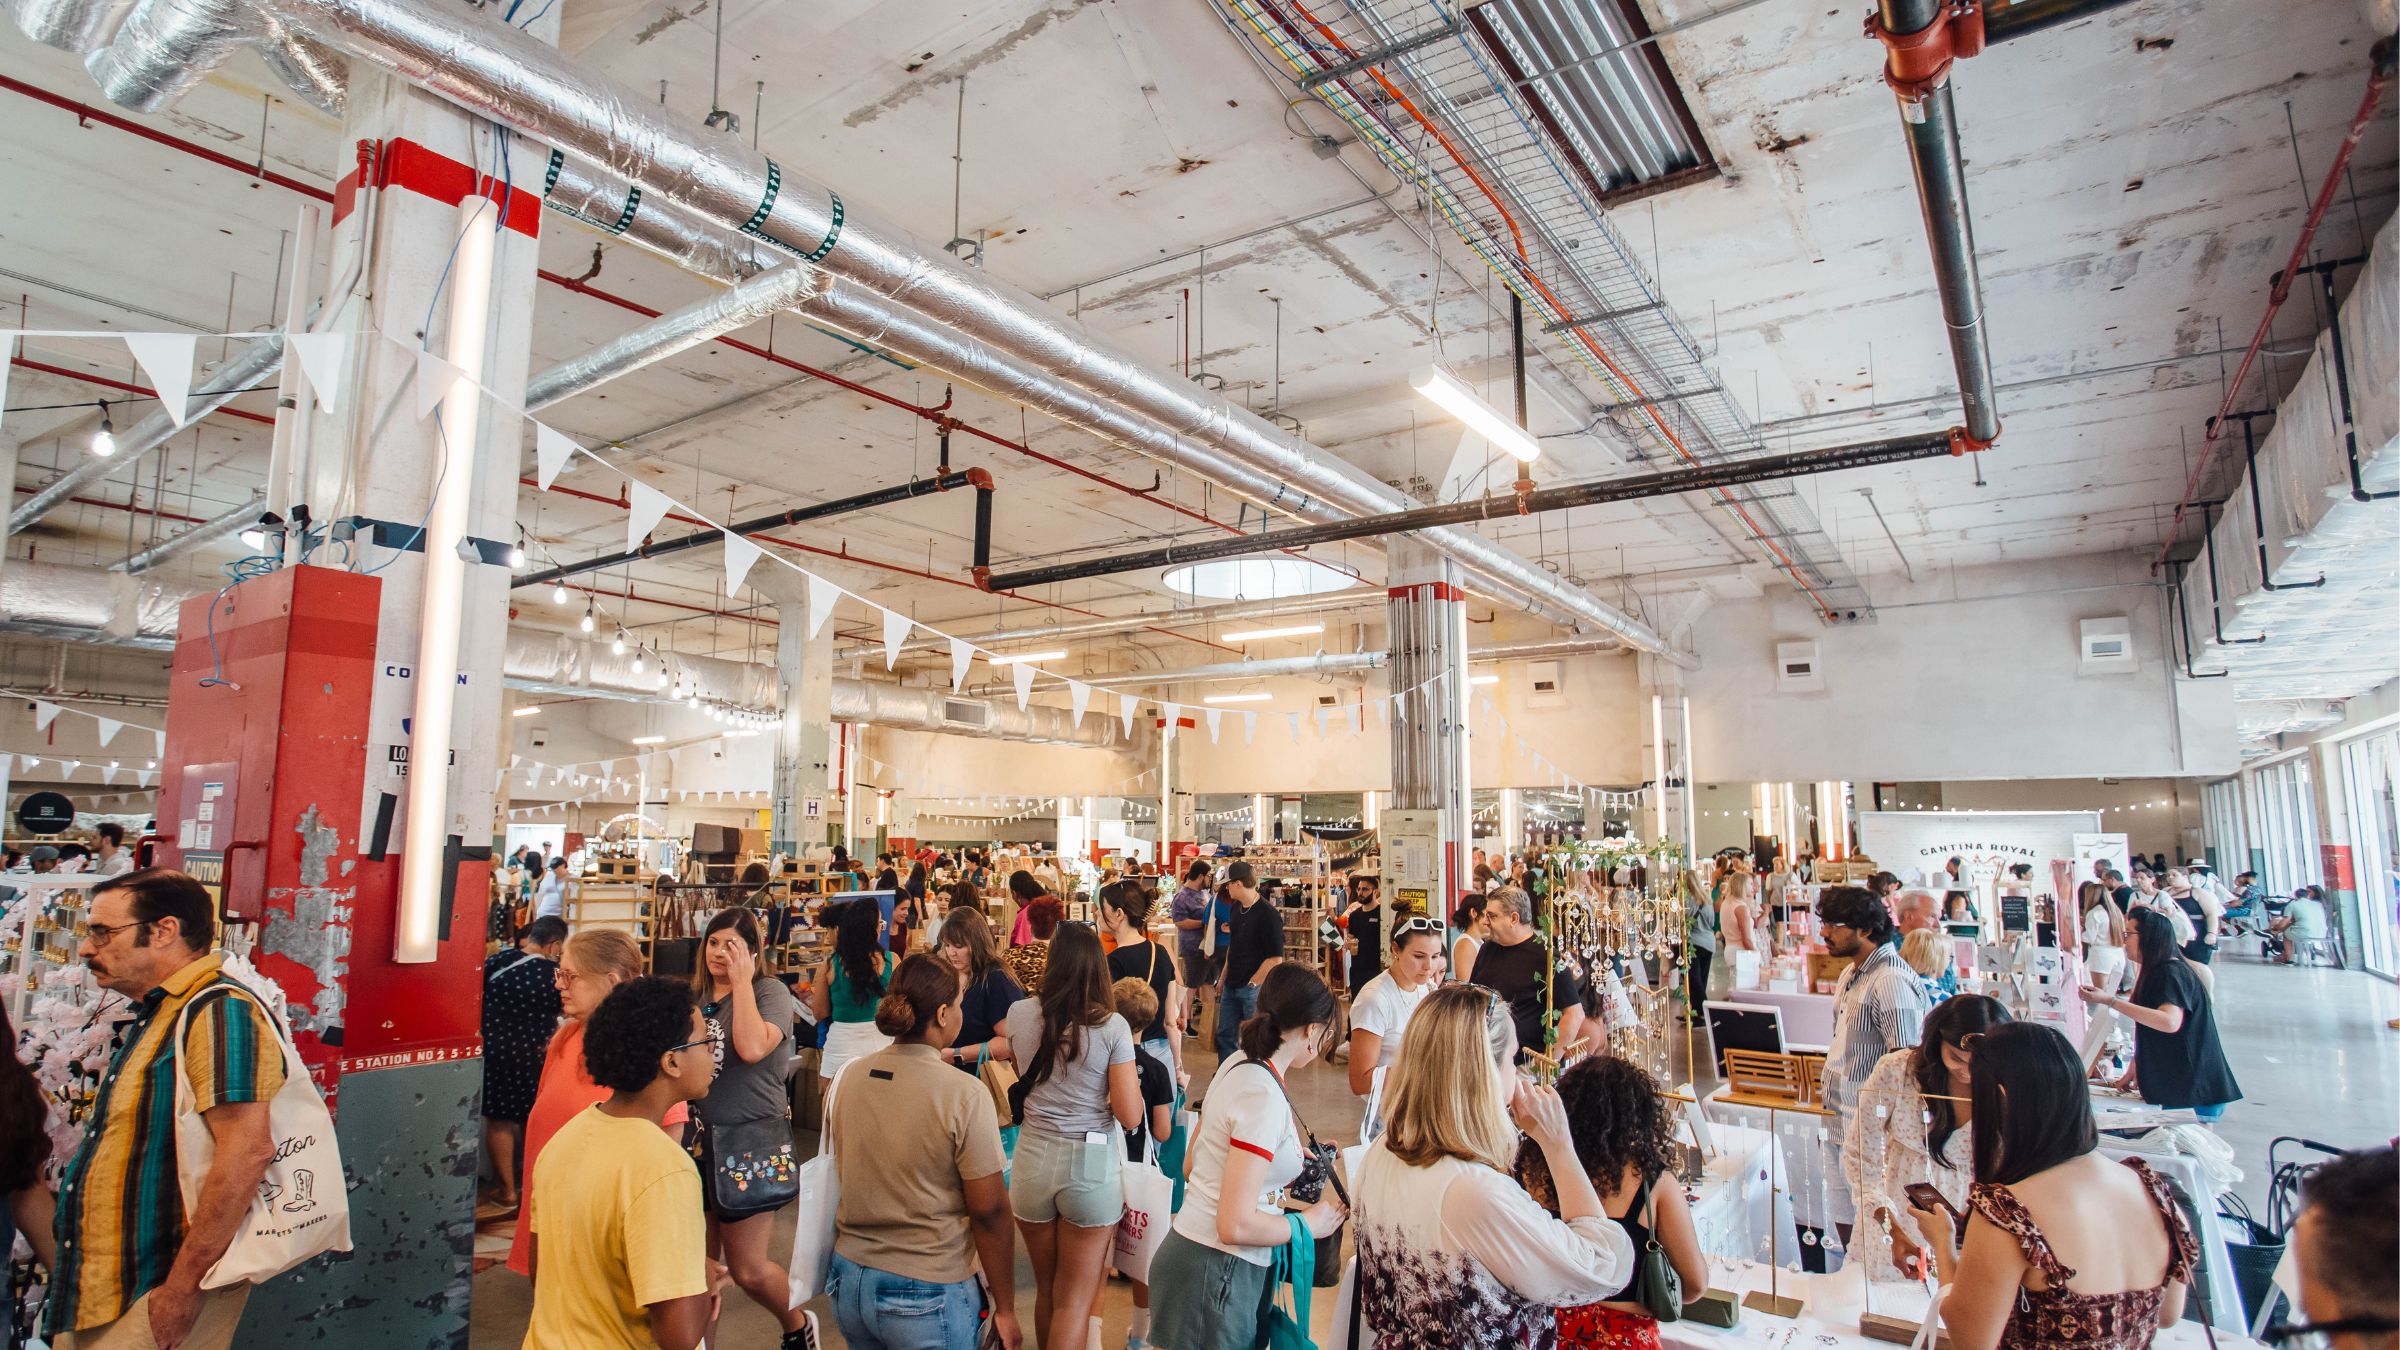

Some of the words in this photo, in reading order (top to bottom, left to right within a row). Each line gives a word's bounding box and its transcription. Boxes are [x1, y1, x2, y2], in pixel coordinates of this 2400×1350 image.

[750, 231, 807, 260] OVERFLOW
[386, 666, 467, 685] CON
[808, 802, 818, 815] H
[1920, 843, 1984, 857] CANTINA
[1990, 844, 2037, 858] ROYAL
[1400, 890, 1426, 898] CAUTION
[356, 1053, 411, 1069] STATION
[417, 1050, 434, 1061] NO
[271, 1136, 317, 1164] ston
